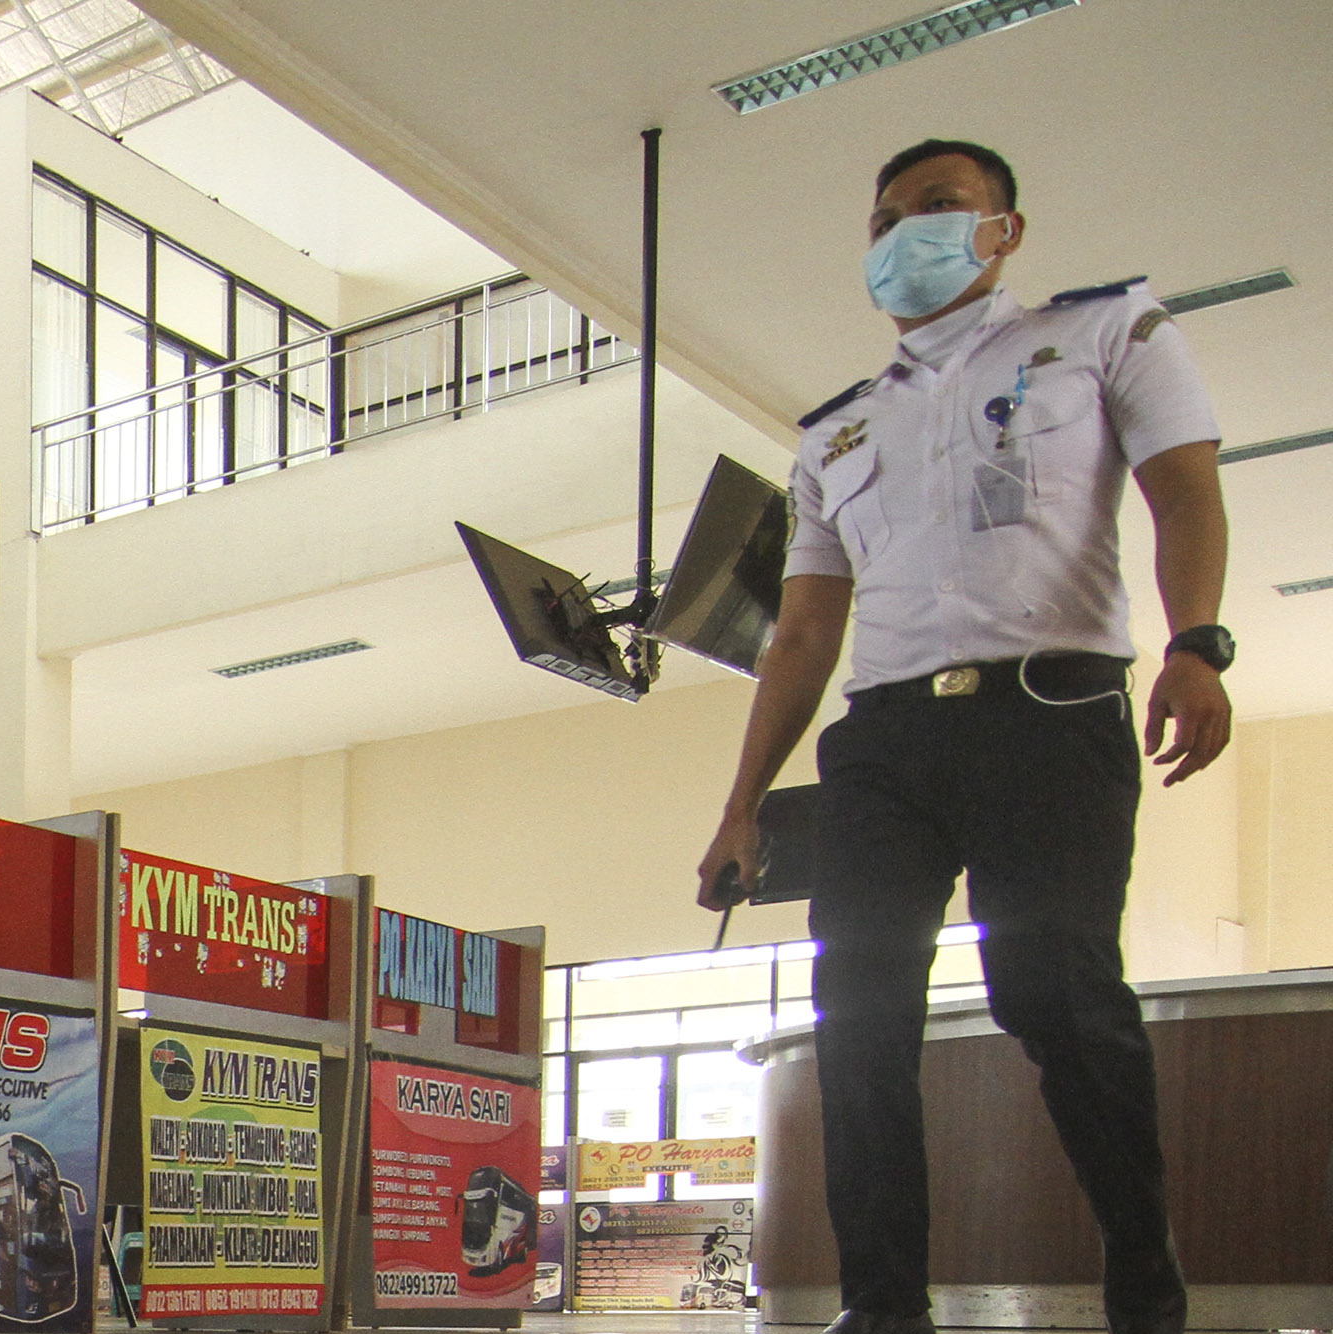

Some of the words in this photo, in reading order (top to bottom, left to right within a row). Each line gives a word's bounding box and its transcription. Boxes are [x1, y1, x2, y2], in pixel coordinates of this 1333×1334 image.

[132, 862, 199, 938] KYM
[204, 885, 296, 955] TRANS
[202, 1048, 249, 1098] KYM
[254, 1055, 319, 1106] TRANS
[396, 1074, 467, 1120] KARYA
[469, 1087, 511, 1126] SARI
[619, 1146, 652, 1163] PO
[661, 1143, 755, 1163] Haryanto
